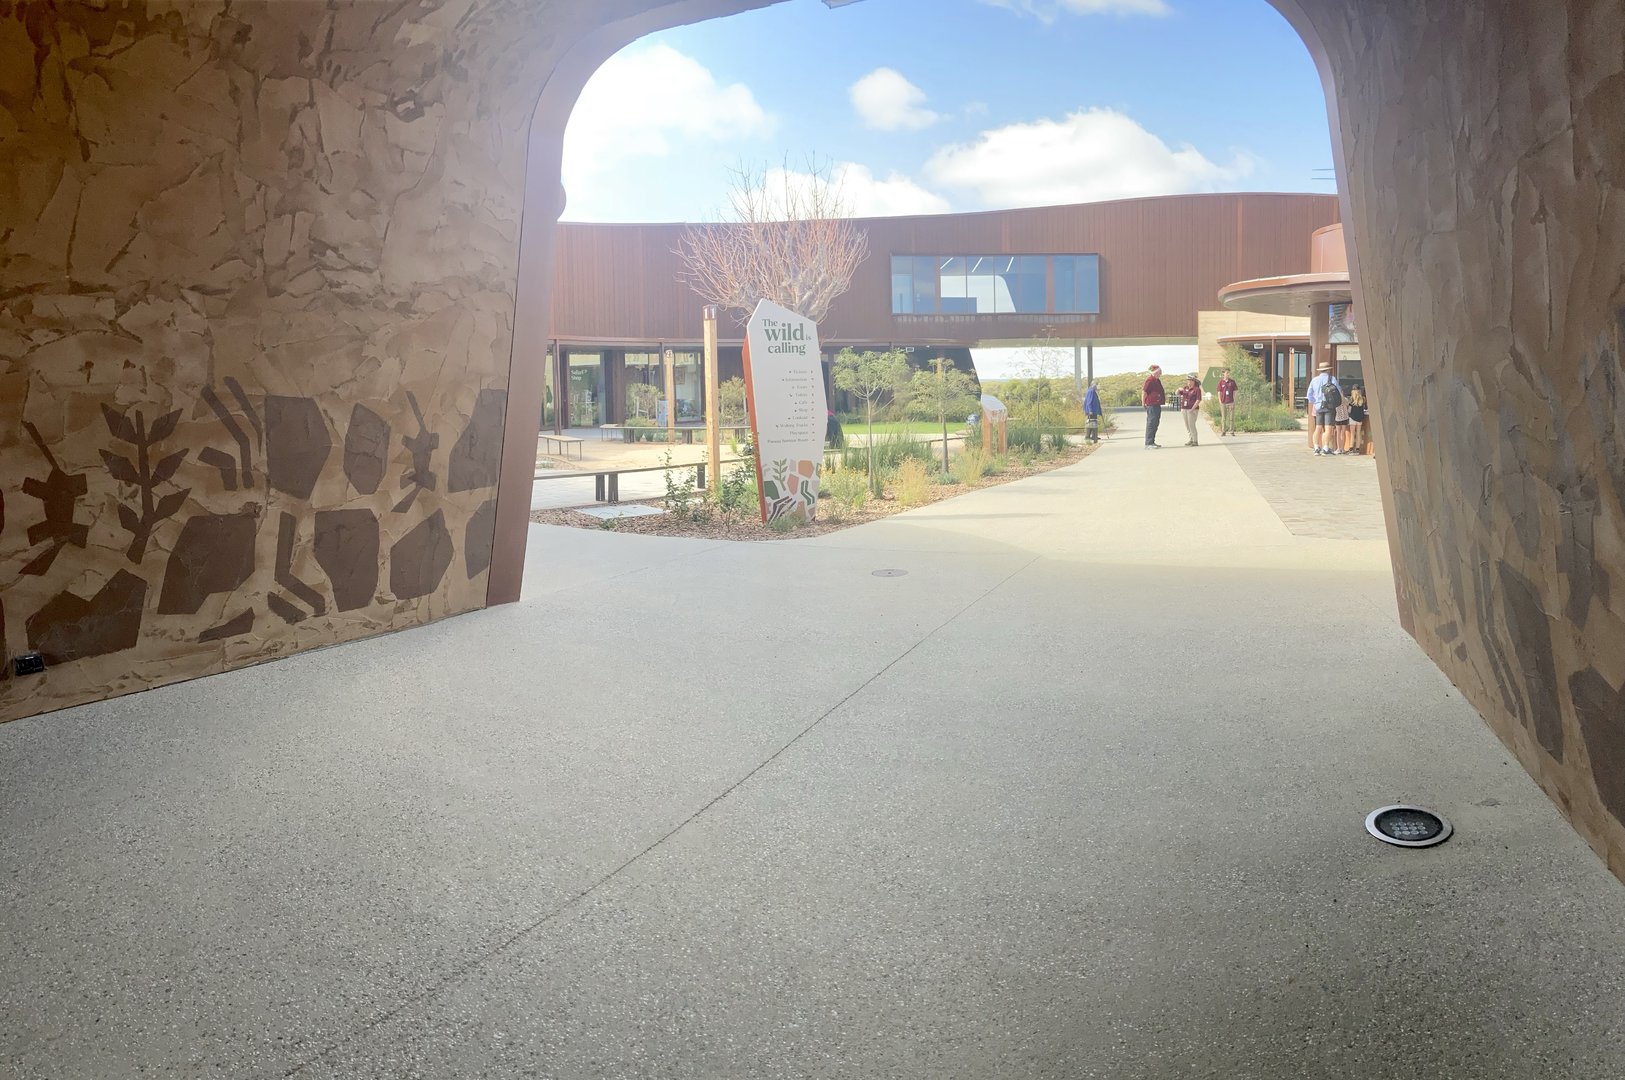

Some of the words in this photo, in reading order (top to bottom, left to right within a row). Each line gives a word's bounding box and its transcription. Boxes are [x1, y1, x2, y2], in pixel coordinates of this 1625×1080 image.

[762, 319, 778, 327] The
[764, 323, 804, 341] wild
[805, 333, 812, 341] is
[768, 342, 806, 356] calling
